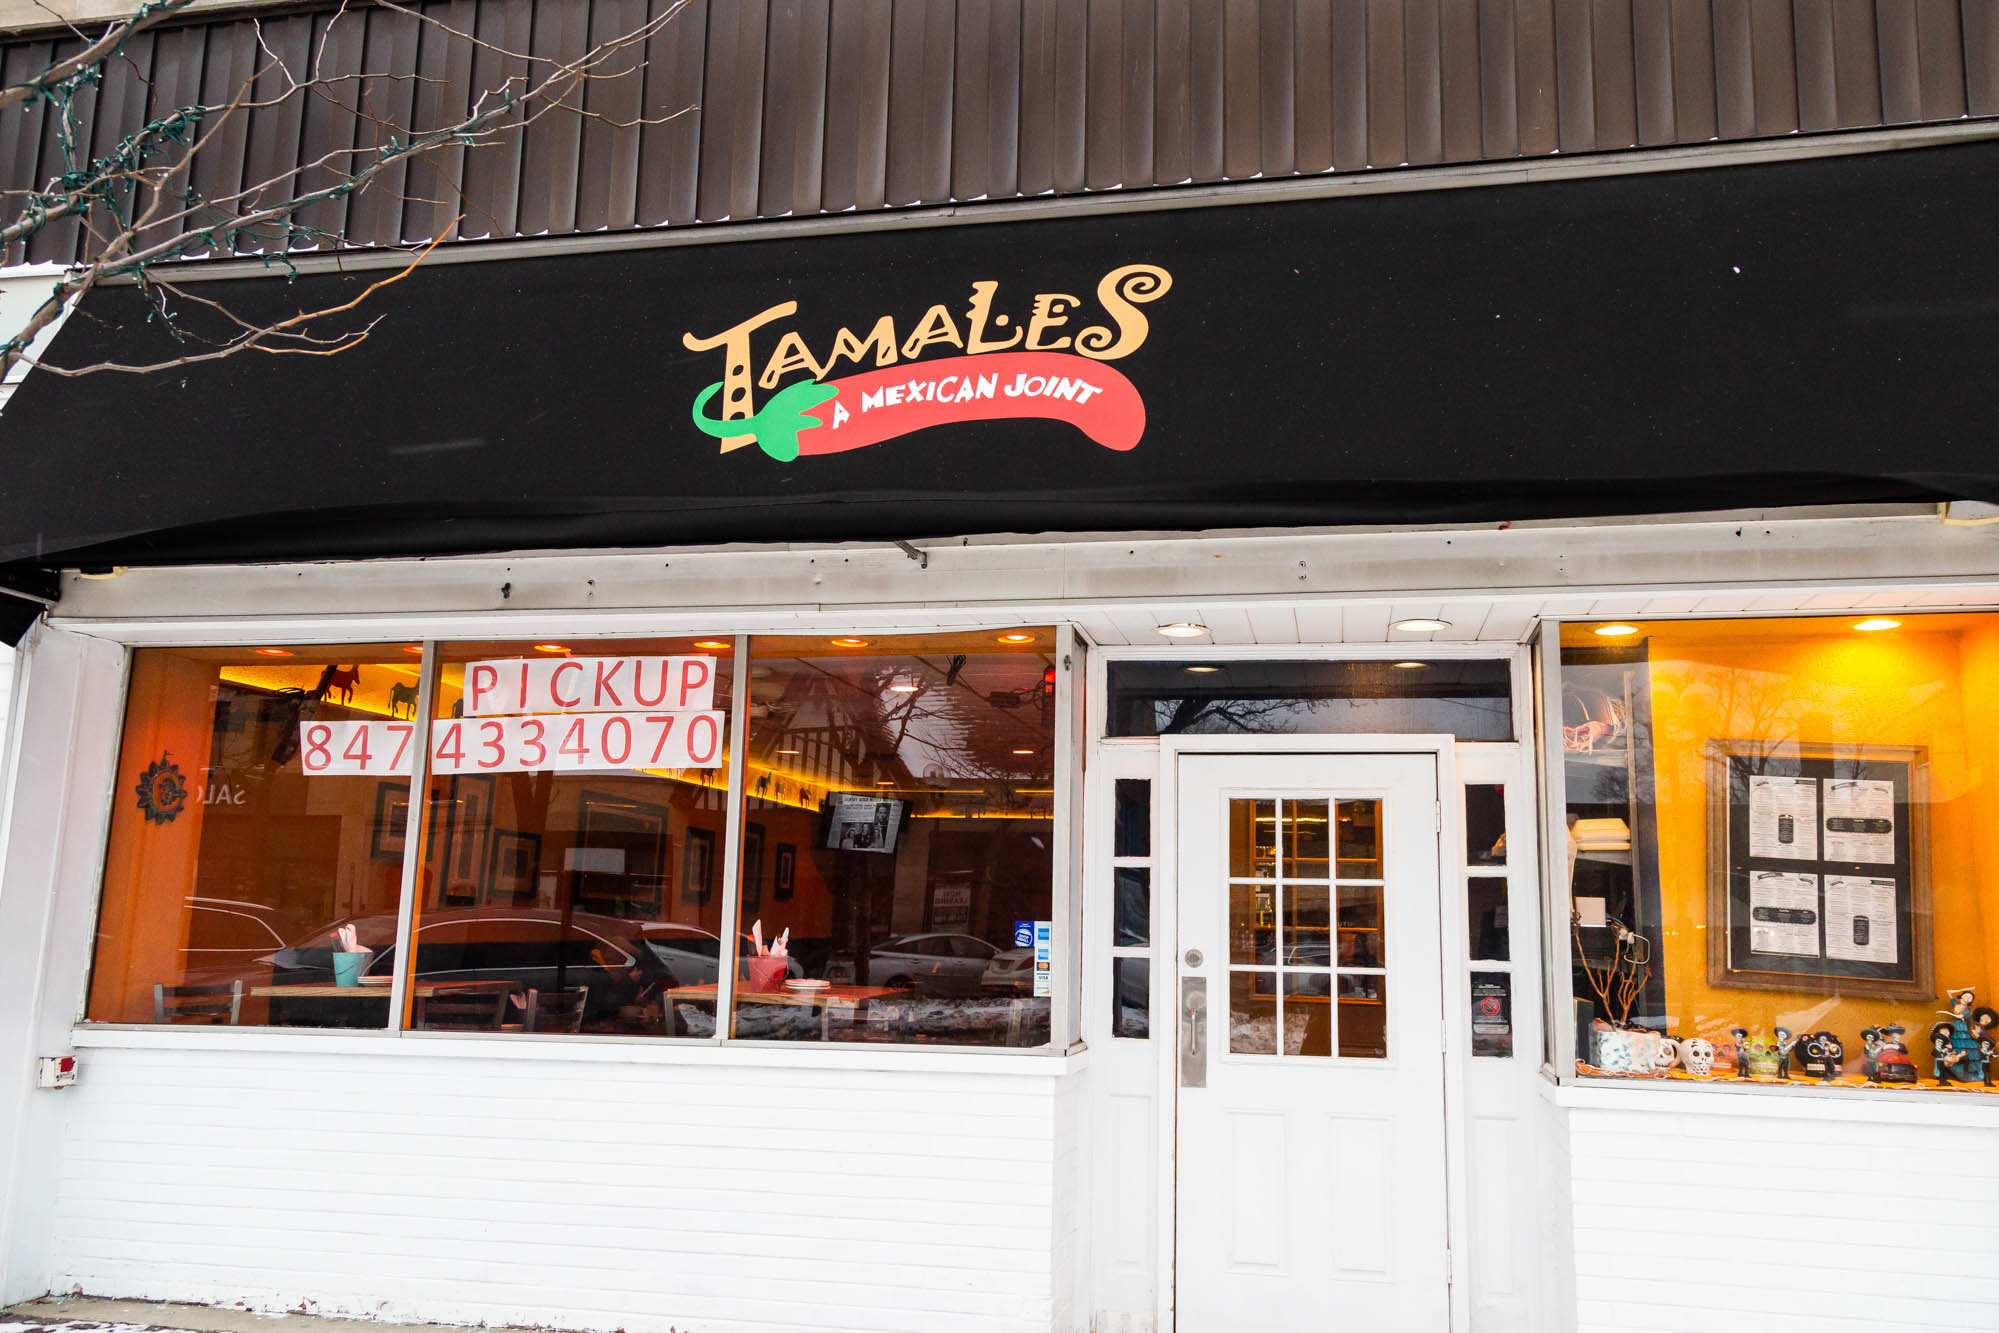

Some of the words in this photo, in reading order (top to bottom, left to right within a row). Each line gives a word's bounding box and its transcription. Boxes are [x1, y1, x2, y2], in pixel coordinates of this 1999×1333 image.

[683, 264, 1173, 454] TAMALES
[832, 400, 850, 429] A
[862, 373, 998, 413] MEXICAN
[1003, 373, 1104, 405] JOINT
[472, 660, 709, 711] PICKUP
[304, 724, 414, 770] 847
[436, 715, 718, 769] 4334070
